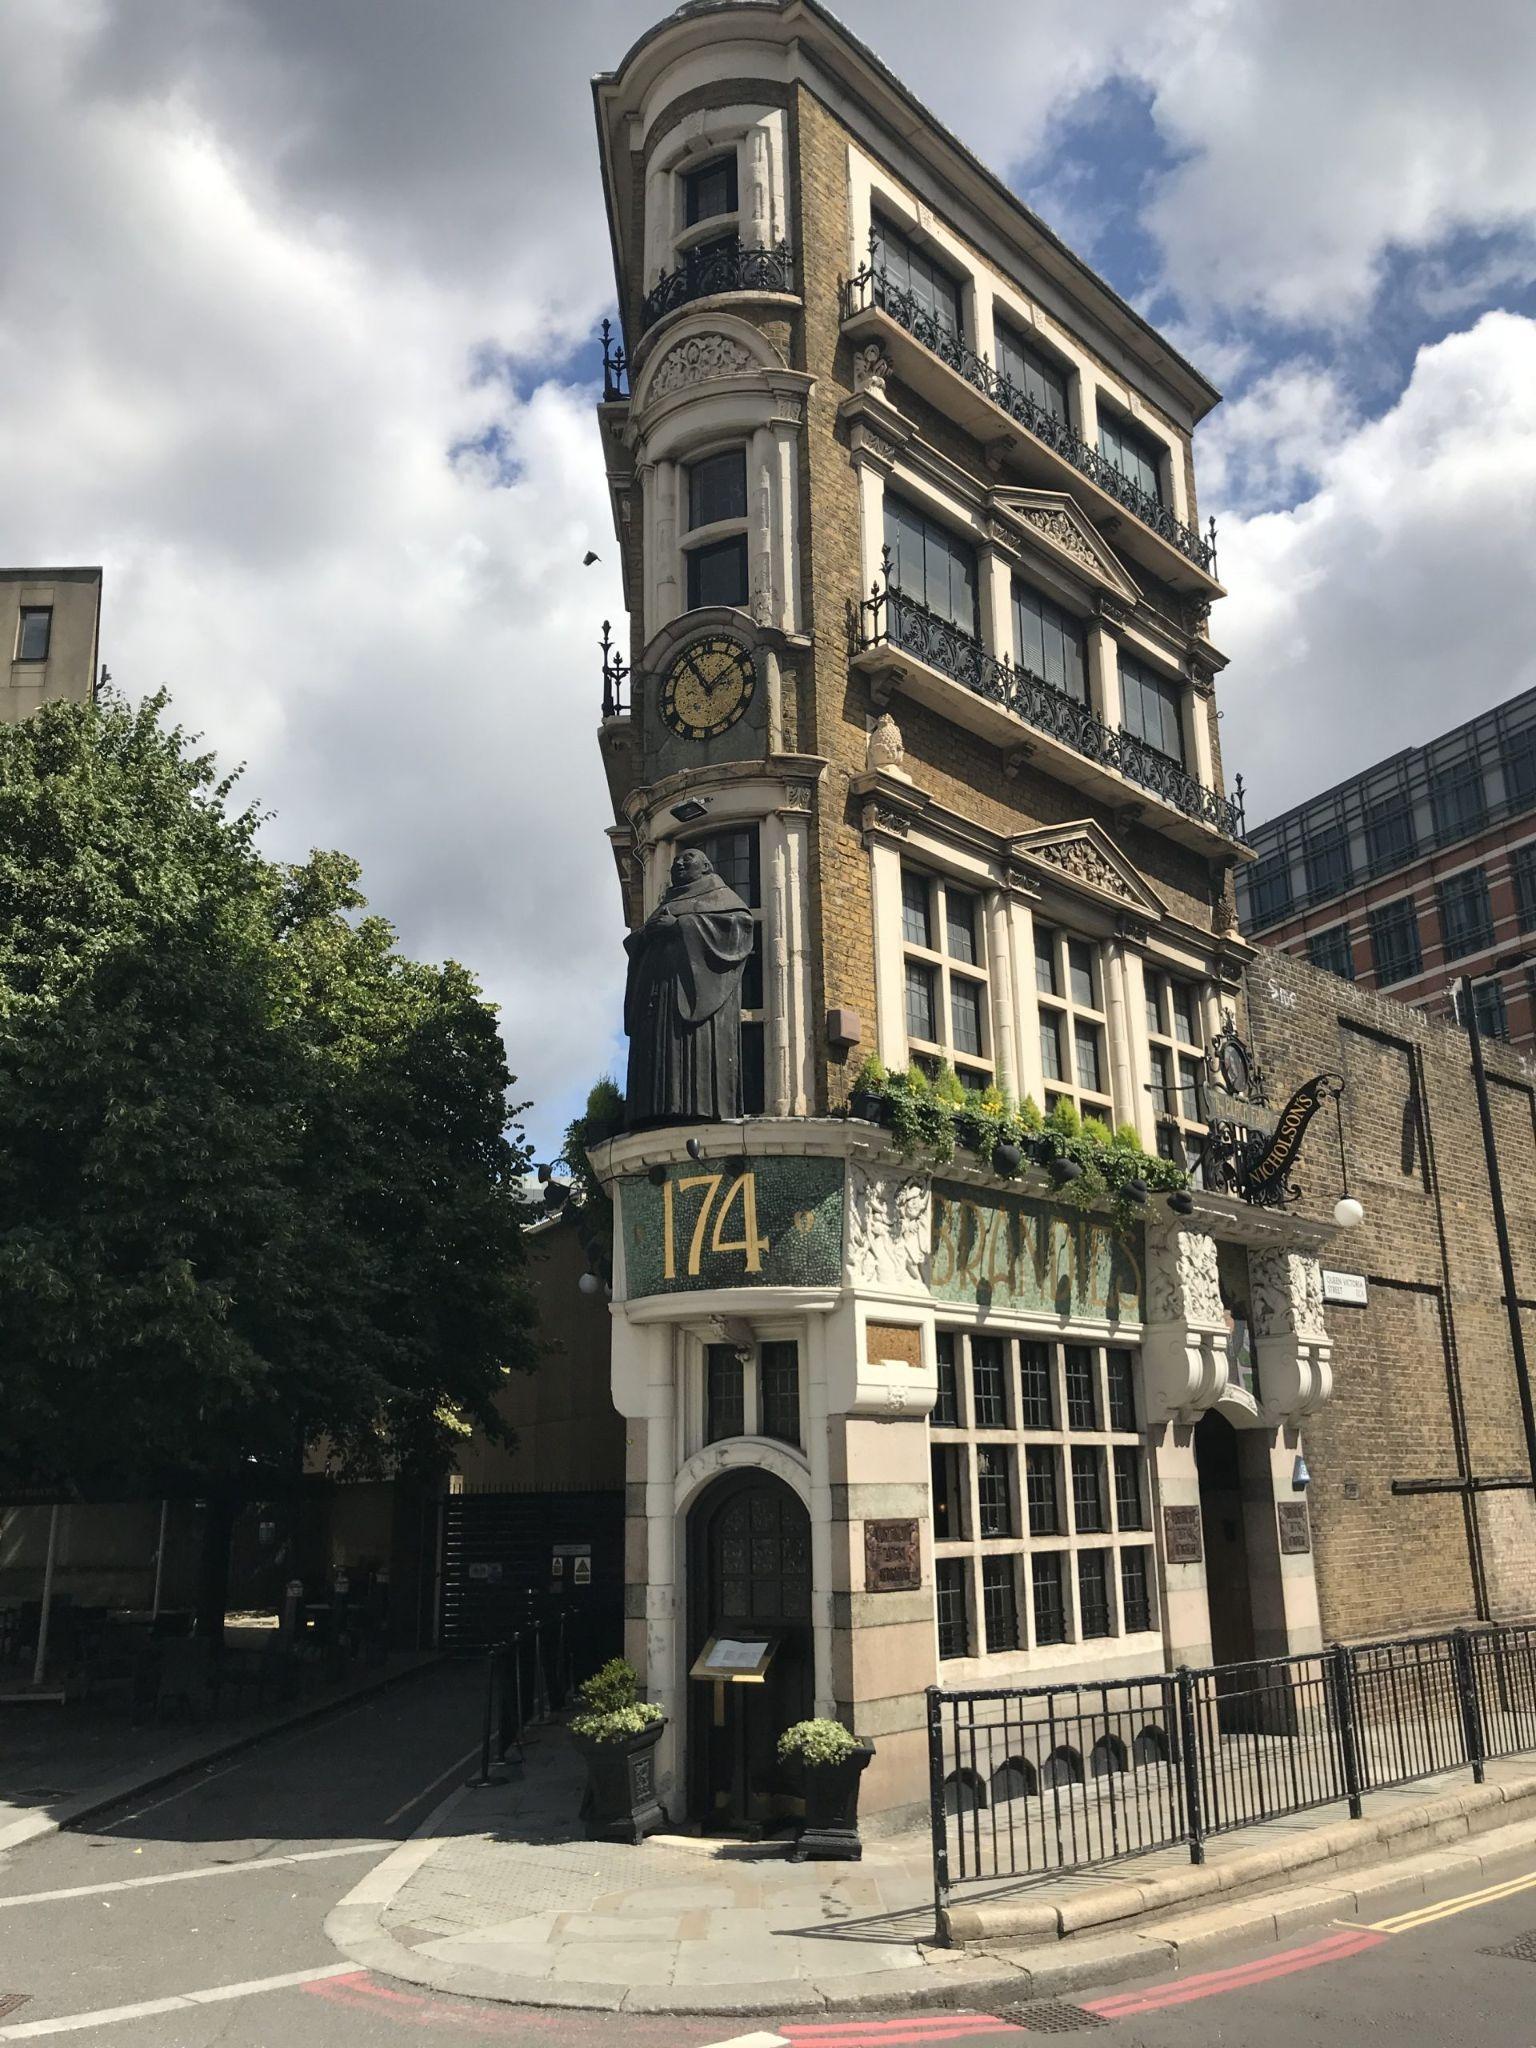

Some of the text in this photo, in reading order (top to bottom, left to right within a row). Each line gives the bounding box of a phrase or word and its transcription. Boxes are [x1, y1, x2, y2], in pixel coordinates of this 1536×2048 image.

[662, 1172, 770, 1279] 174
[930, 1196, 1142, 1312] BRANDIES
[1327, 1275, 1363, 1288] QUEEN VICTORIA
[1328, 1285, 1343, 1295] STREET
